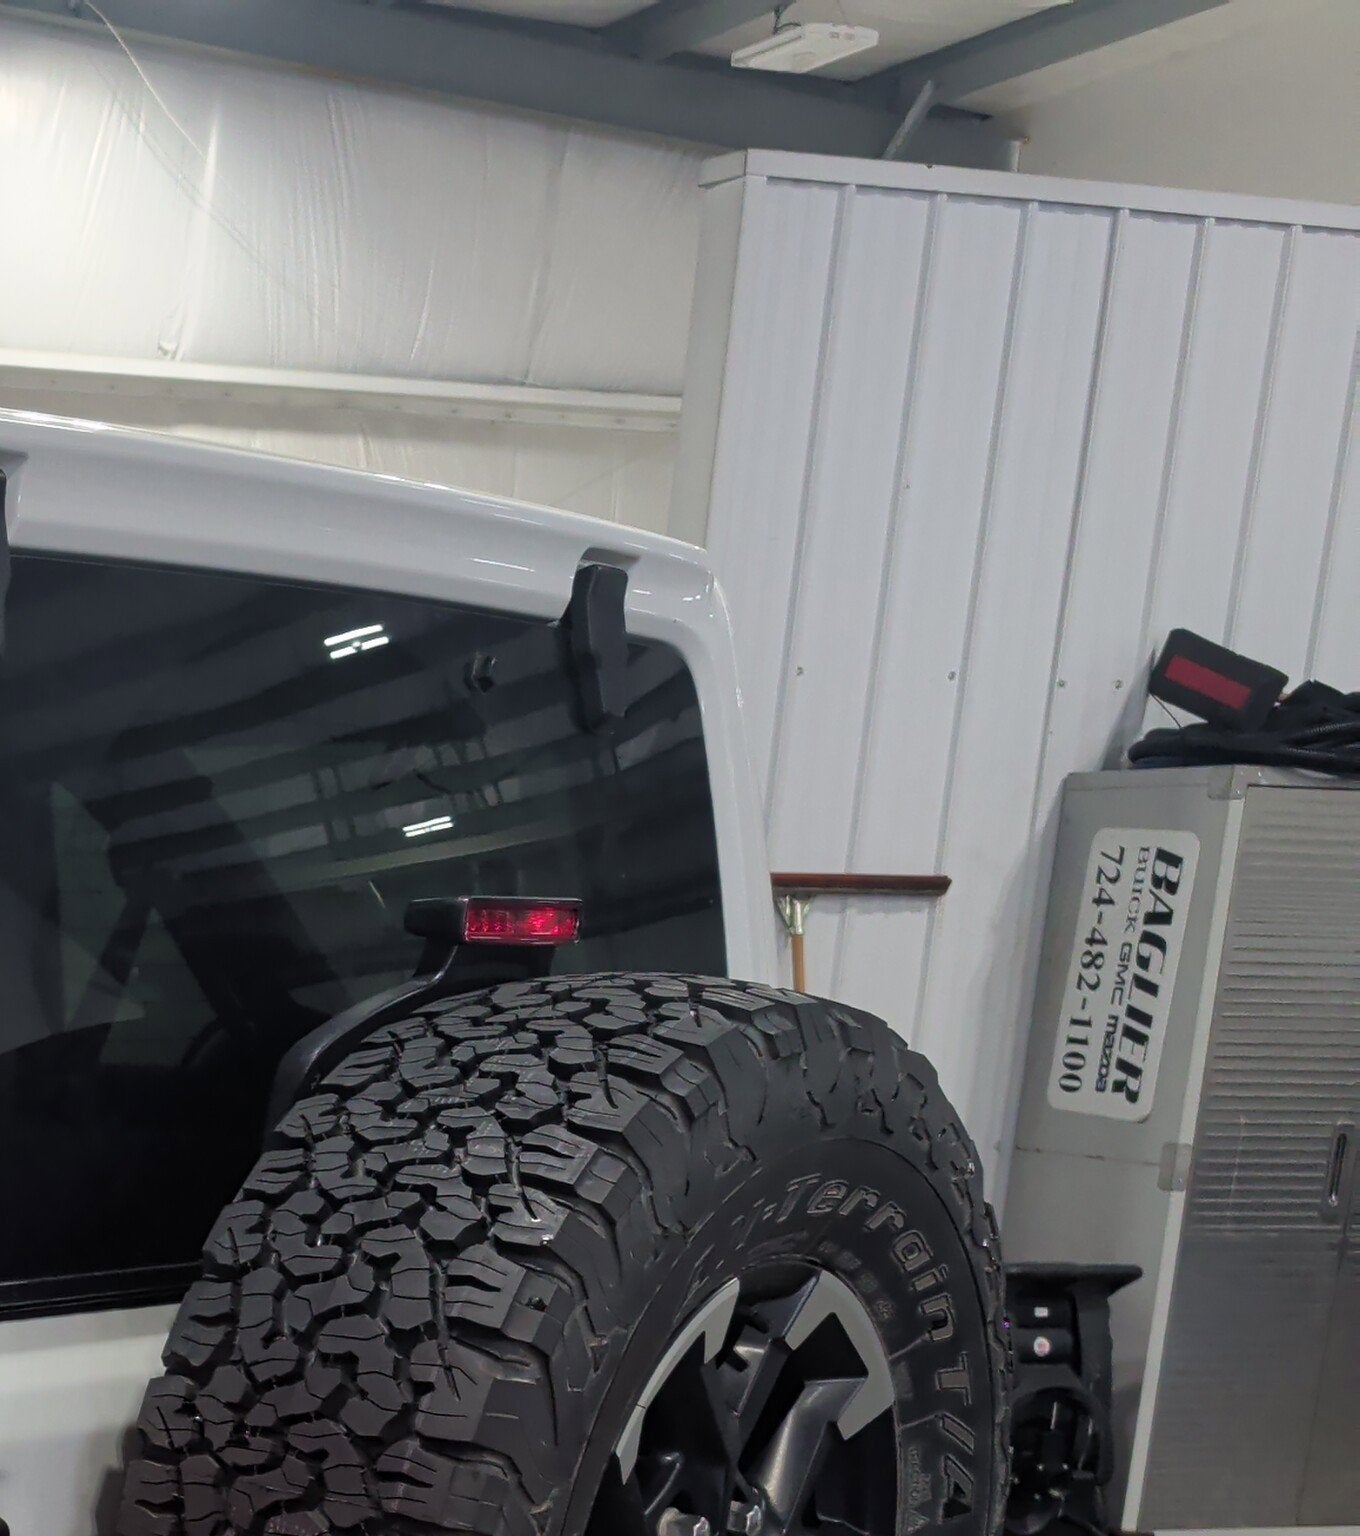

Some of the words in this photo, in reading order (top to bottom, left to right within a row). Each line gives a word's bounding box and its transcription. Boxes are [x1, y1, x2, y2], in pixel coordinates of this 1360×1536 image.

[1058, 845, 1126, 1093] 724-482-1100
[1111, 942, 1134, 1006] GMC
[1124, 846, 1150, 934] BUICK
[1111, 846, 1184, 1104] BAGLIER
